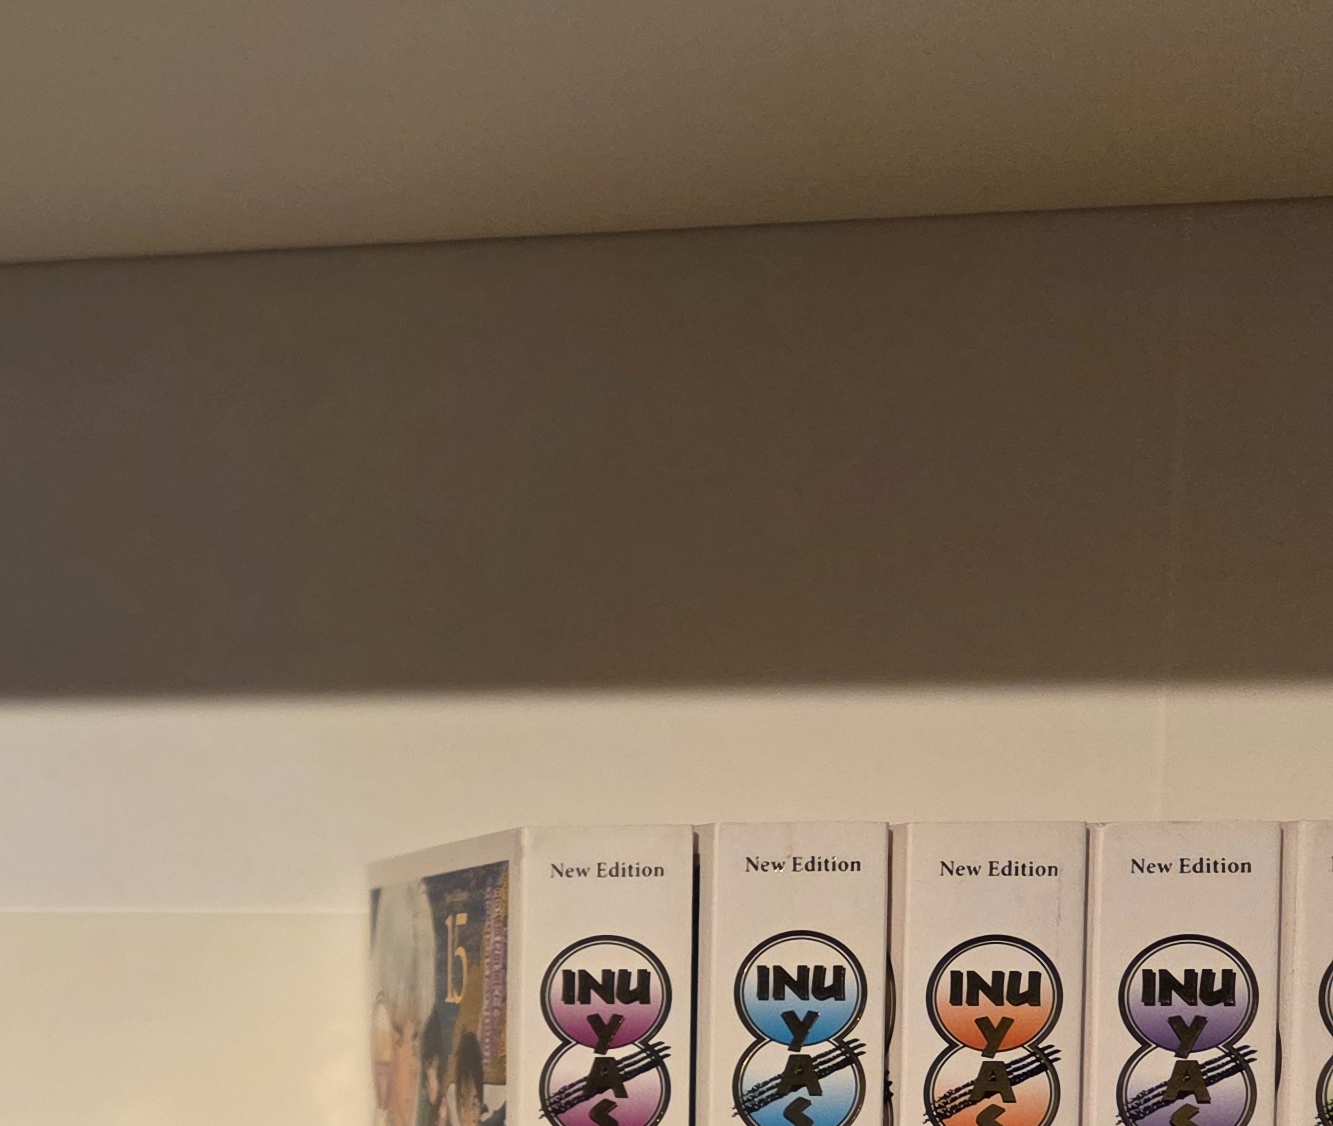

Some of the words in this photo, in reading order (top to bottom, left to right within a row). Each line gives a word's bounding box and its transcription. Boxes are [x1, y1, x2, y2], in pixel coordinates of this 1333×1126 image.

[551, 863, 590, 878] New
[597, 862, 664, 877] Edition
[746, 857, 785, 872] New
[792, 856, 860, 872] Edition
[941, 861, 981, 876] New
[988, 860, 1058, 876] Edition
[1131, 859, 1172, 873] New
[1179, 857, 1251, 873] Edition
[444, 912, 468, 1005] 15
[562, 969, 651, 1006] INU
[756, 965, 847, 1002] INU
[949, 970, 1042, 1007] INU
[1141, 967, 1237, 1008] INU
